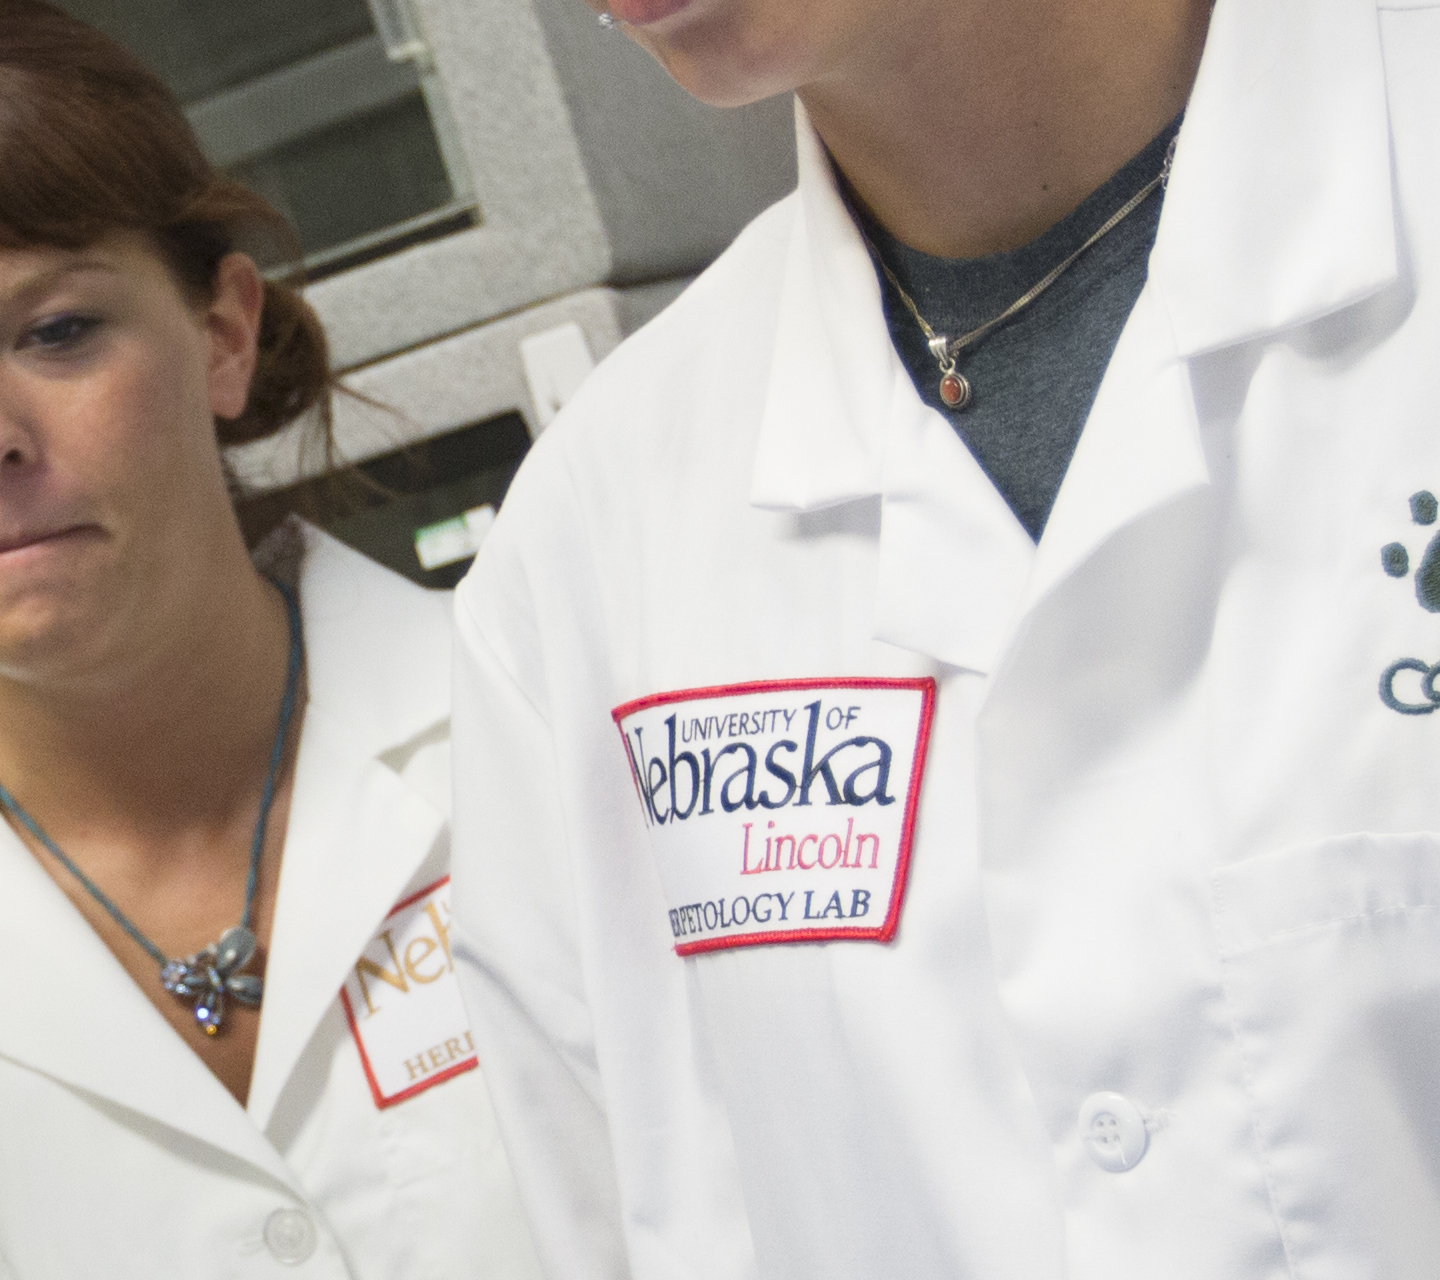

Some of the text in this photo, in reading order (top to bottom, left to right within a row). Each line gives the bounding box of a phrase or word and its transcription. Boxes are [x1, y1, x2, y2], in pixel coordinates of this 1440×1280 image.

[682, 706, 861, 743] UNIVERSITY OF
[626, 699, 896, 829] Nebraska
[740, 818, 880, 875] Lincoln
[803, 889, 871, 920] LAB
